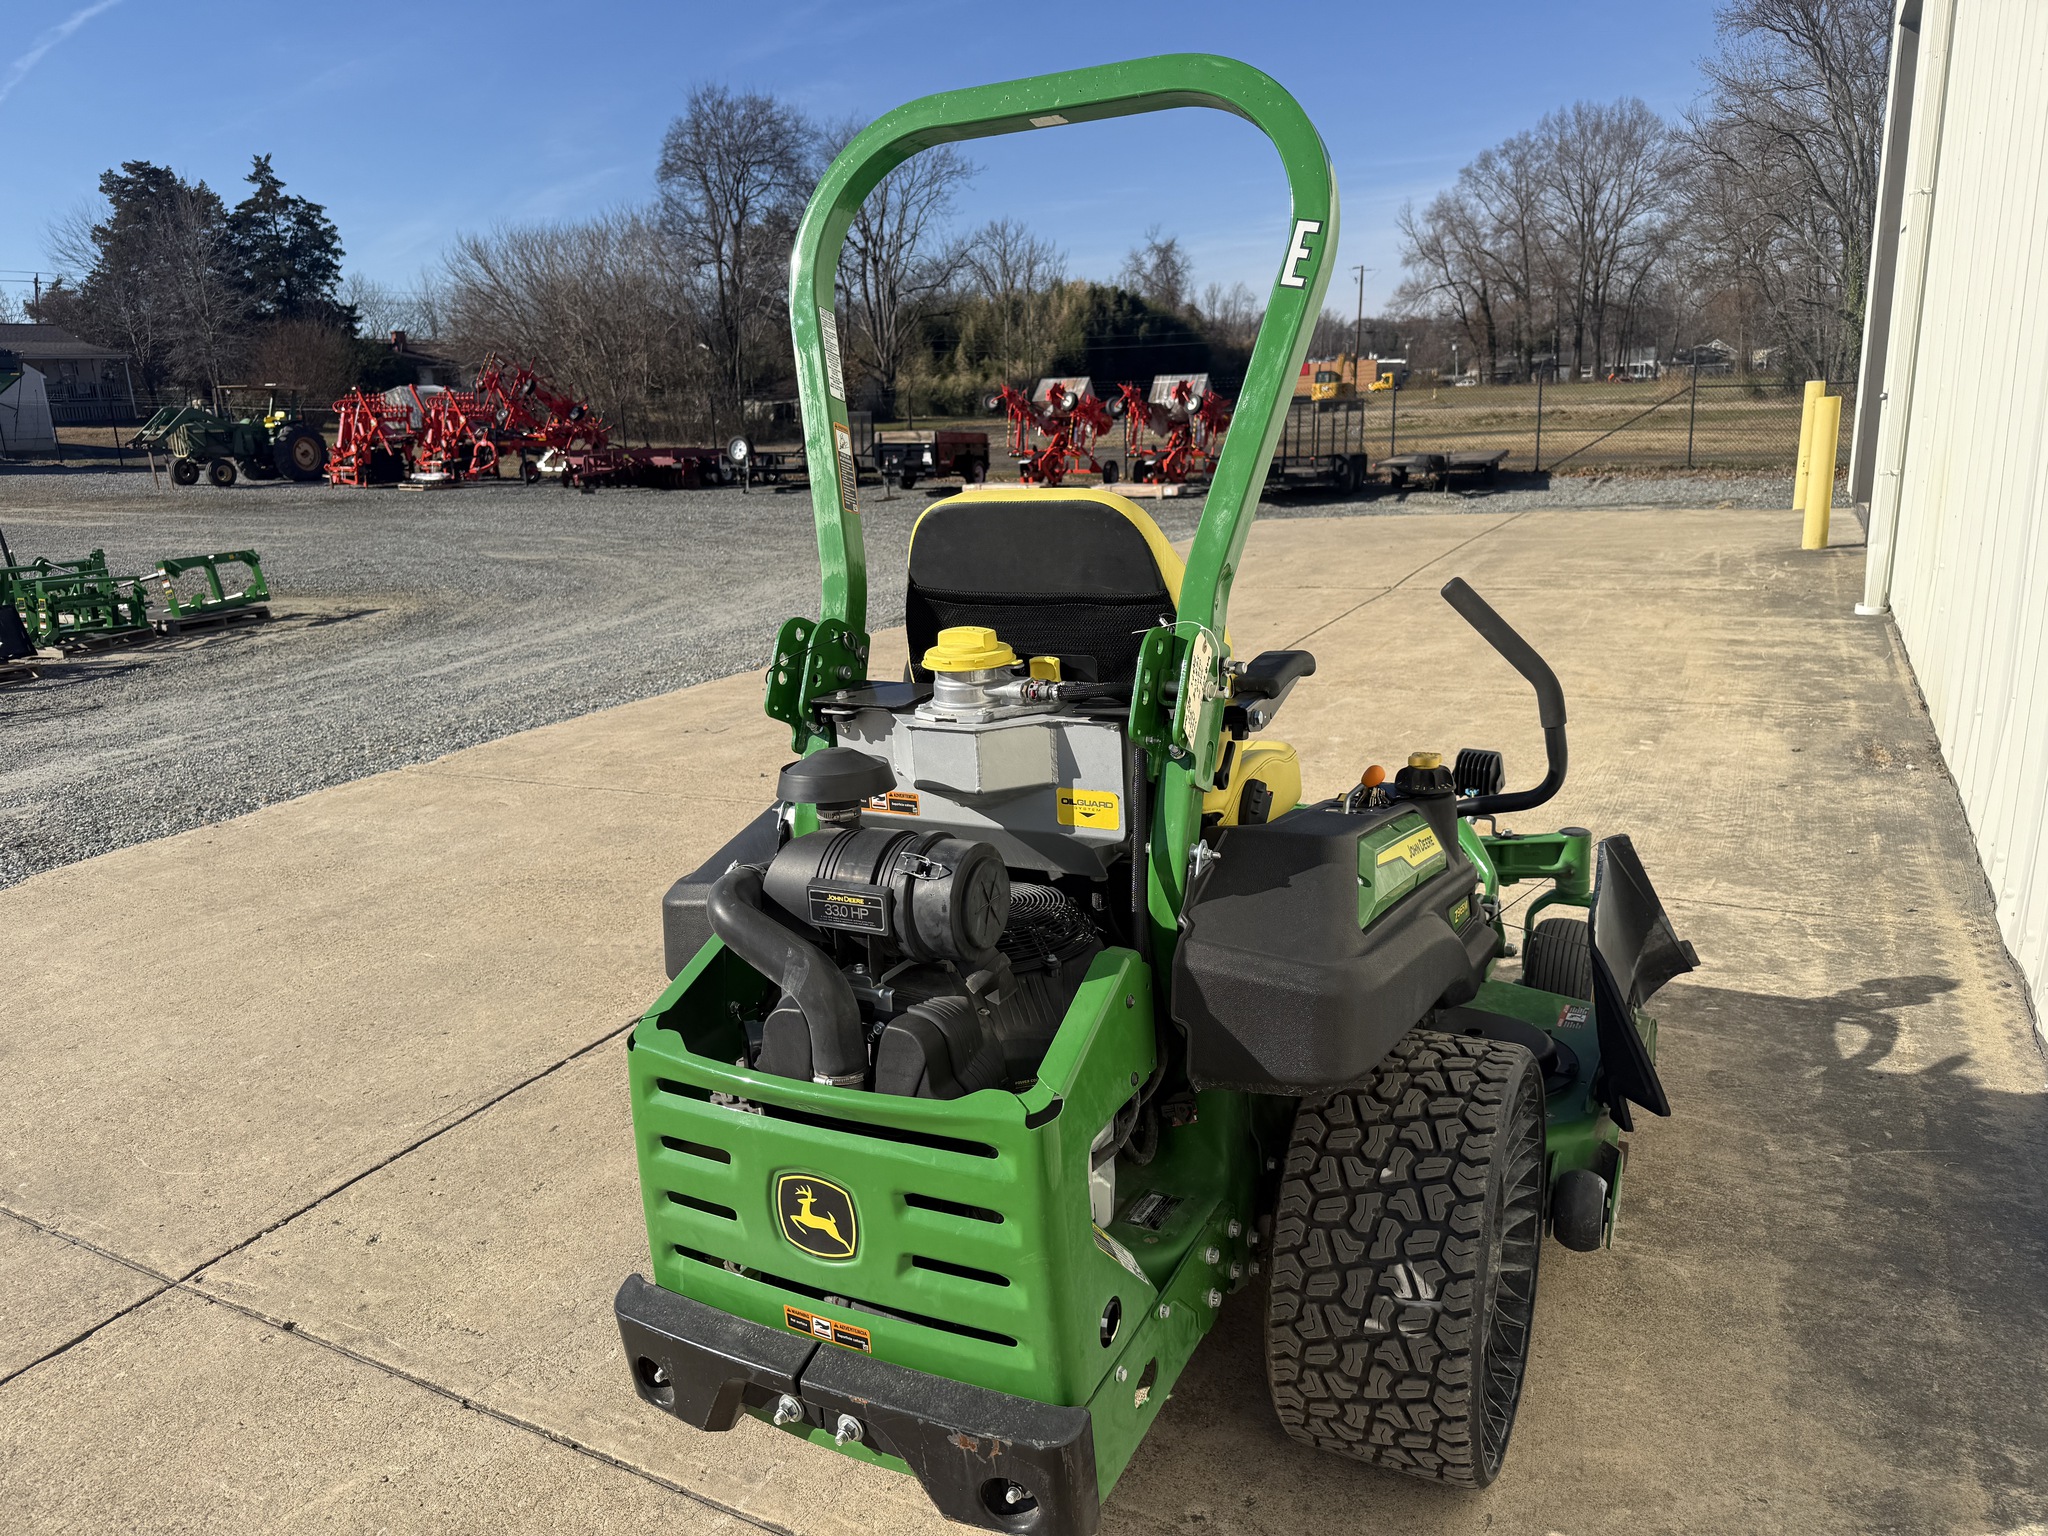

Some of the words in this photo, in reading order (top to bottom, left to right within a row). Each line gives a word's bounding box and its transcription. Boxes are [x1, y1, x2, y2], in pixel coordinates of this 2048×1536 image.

[1280, 219, 1323, 289] E
[1061, 798, 1113, 808] OILGUARD
[1407, 843, 1421, 858] JOHN
[1418, 836, 1434, 851] DEERE
[826, 894, 843, 902] JOHN
[843, 896, 865, 905] DEERE
[824, 903, 848, 917] 33.0
[850, 907, 869, 919] HP
